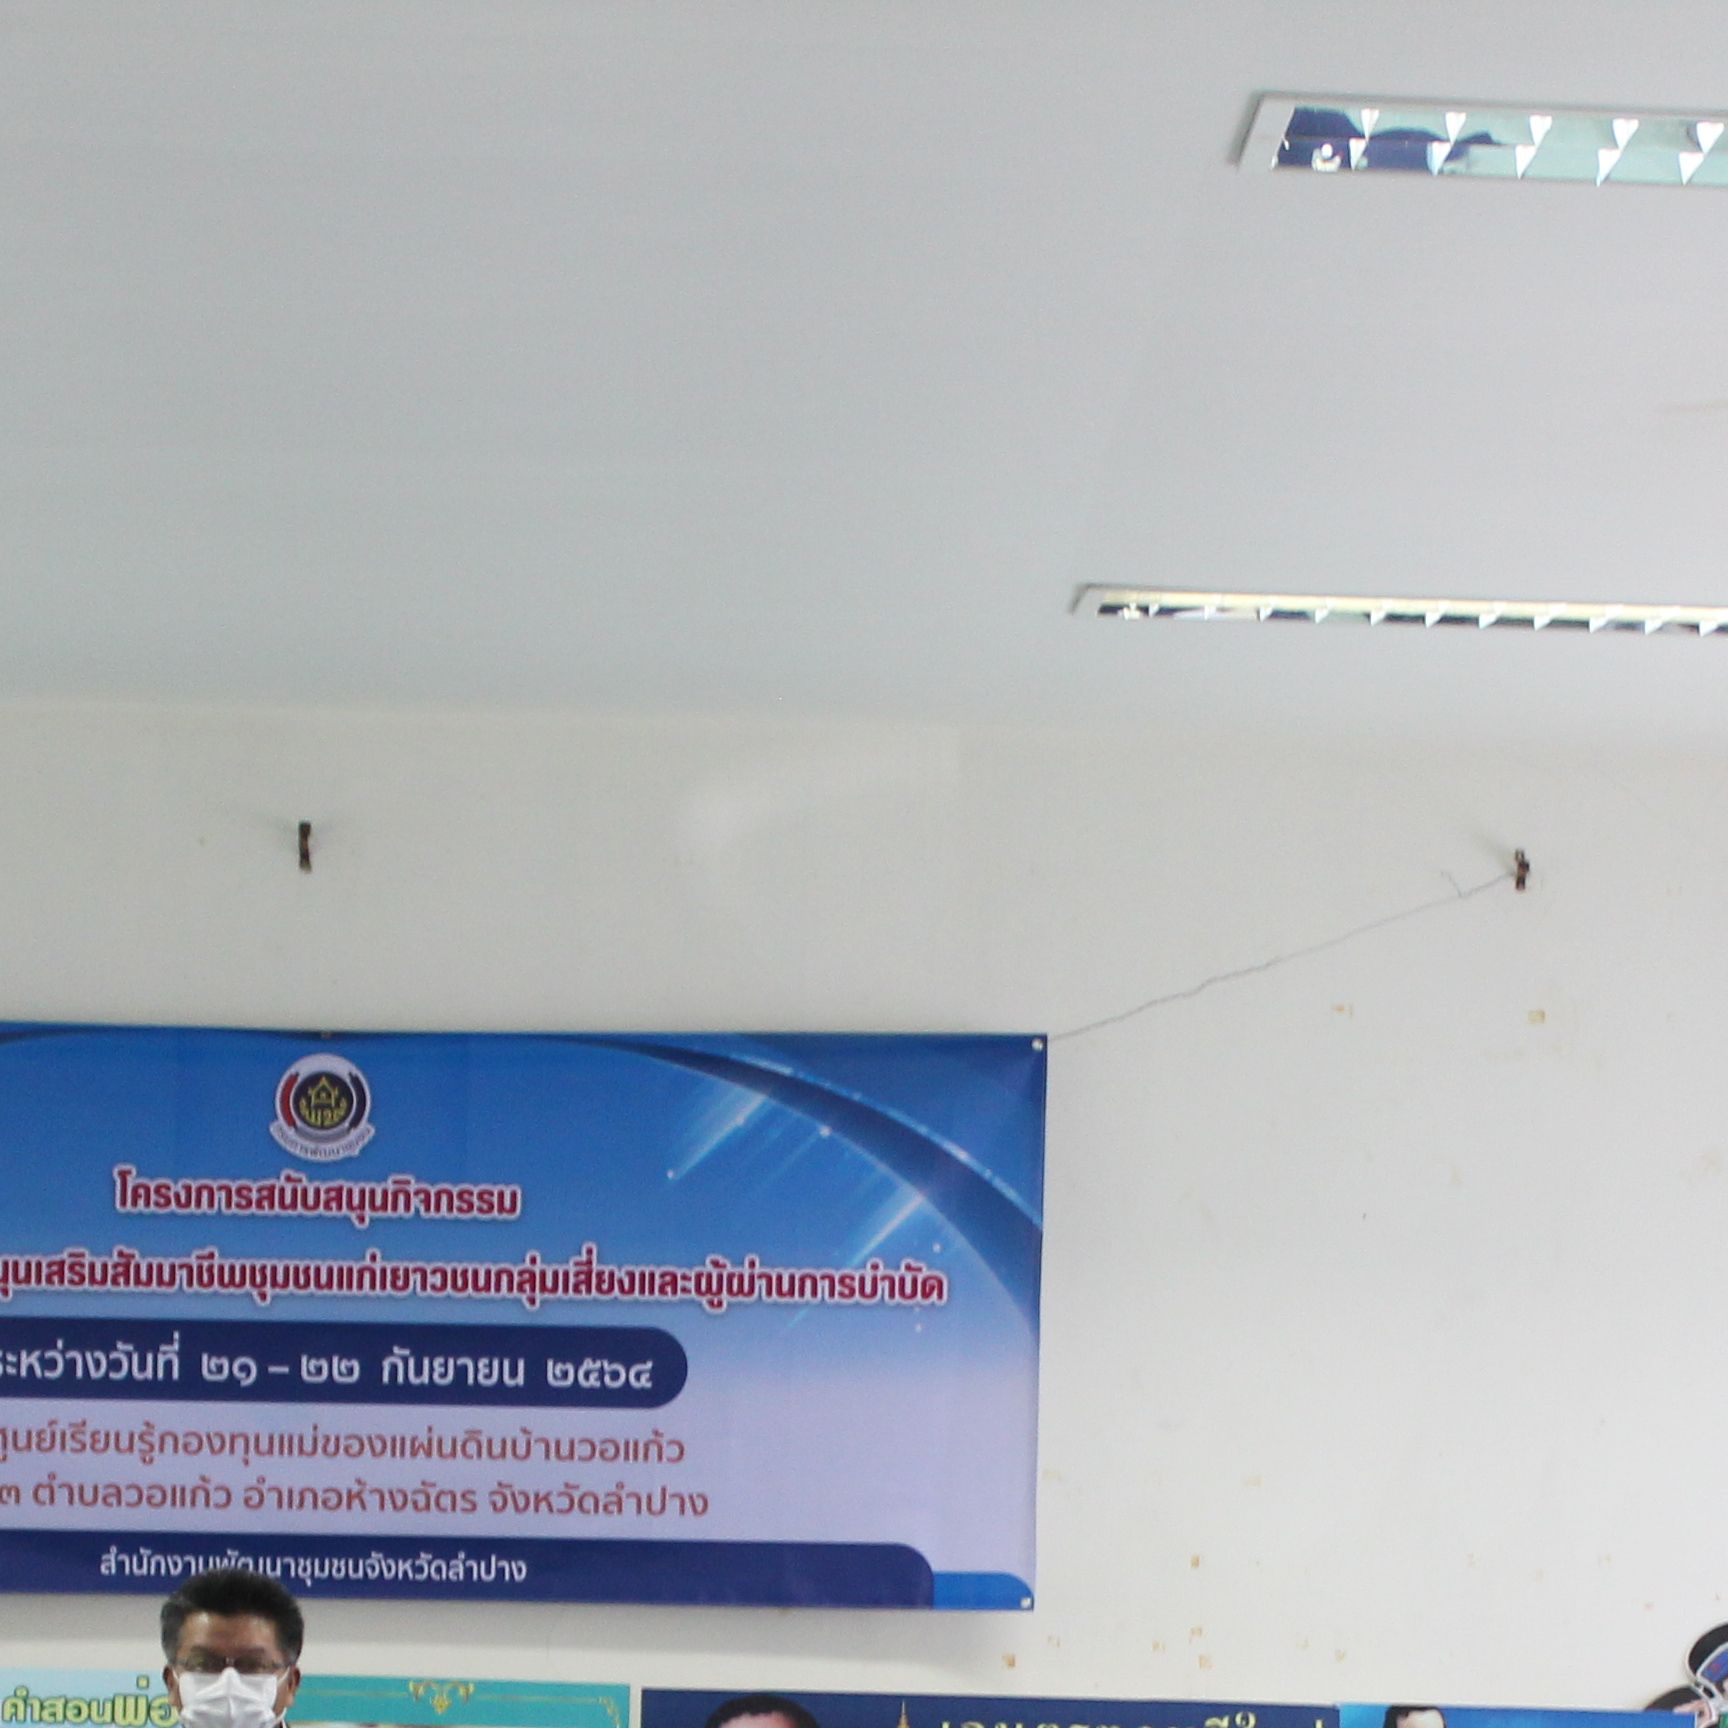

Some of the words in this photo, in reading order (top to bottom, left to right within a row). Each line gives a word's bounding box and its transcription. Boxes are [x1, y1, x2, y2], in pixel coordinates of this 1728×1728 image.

[116, 1168, 520, 1225] โครงการสนับสนุนกิจกรรม
[200, 1357, 258, 1387] ๒๑
[299, 1353, 361, 1386] ๒๒
[380, 1346, 526, 1387] กันยายน
[545, 1357, 654, 1390] ๒๕๖๔
[32, 1471, 233, 1511] ตำบลวอแก้ว
[242, 1474, 478, 1518] อำเภอห้างฉัตร
[487, 1479, 710, 1519] จังหวัดลำปาง
